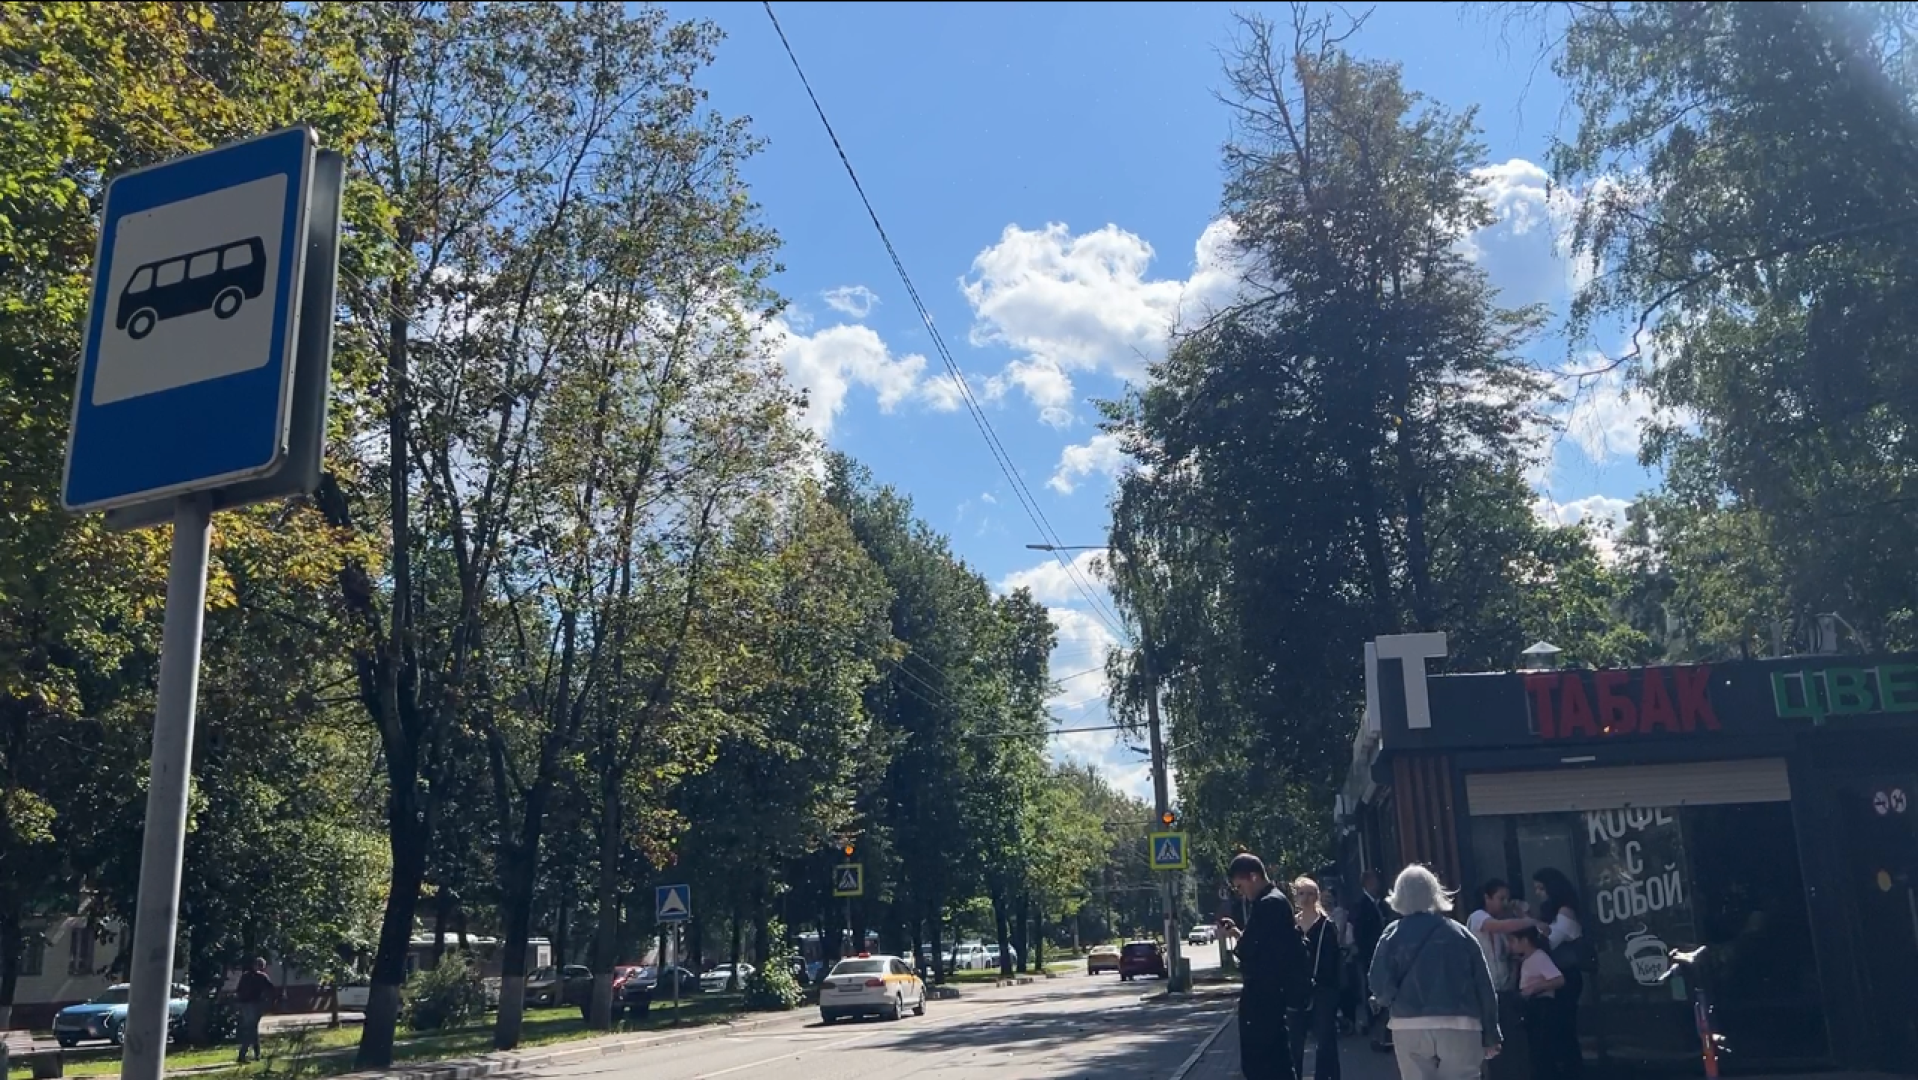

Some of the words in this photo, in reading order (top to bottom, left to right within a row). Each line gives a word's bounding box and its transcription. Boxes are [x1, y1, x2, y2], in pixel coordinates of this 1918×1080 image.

[1524, 666, 1722, 738] ТАБАК
[1770, 664, 1918, 726] ЦВЕ
[1625, 840, 1643, 875] С
[1597, 862, 1683, 924] СОБОЙ
